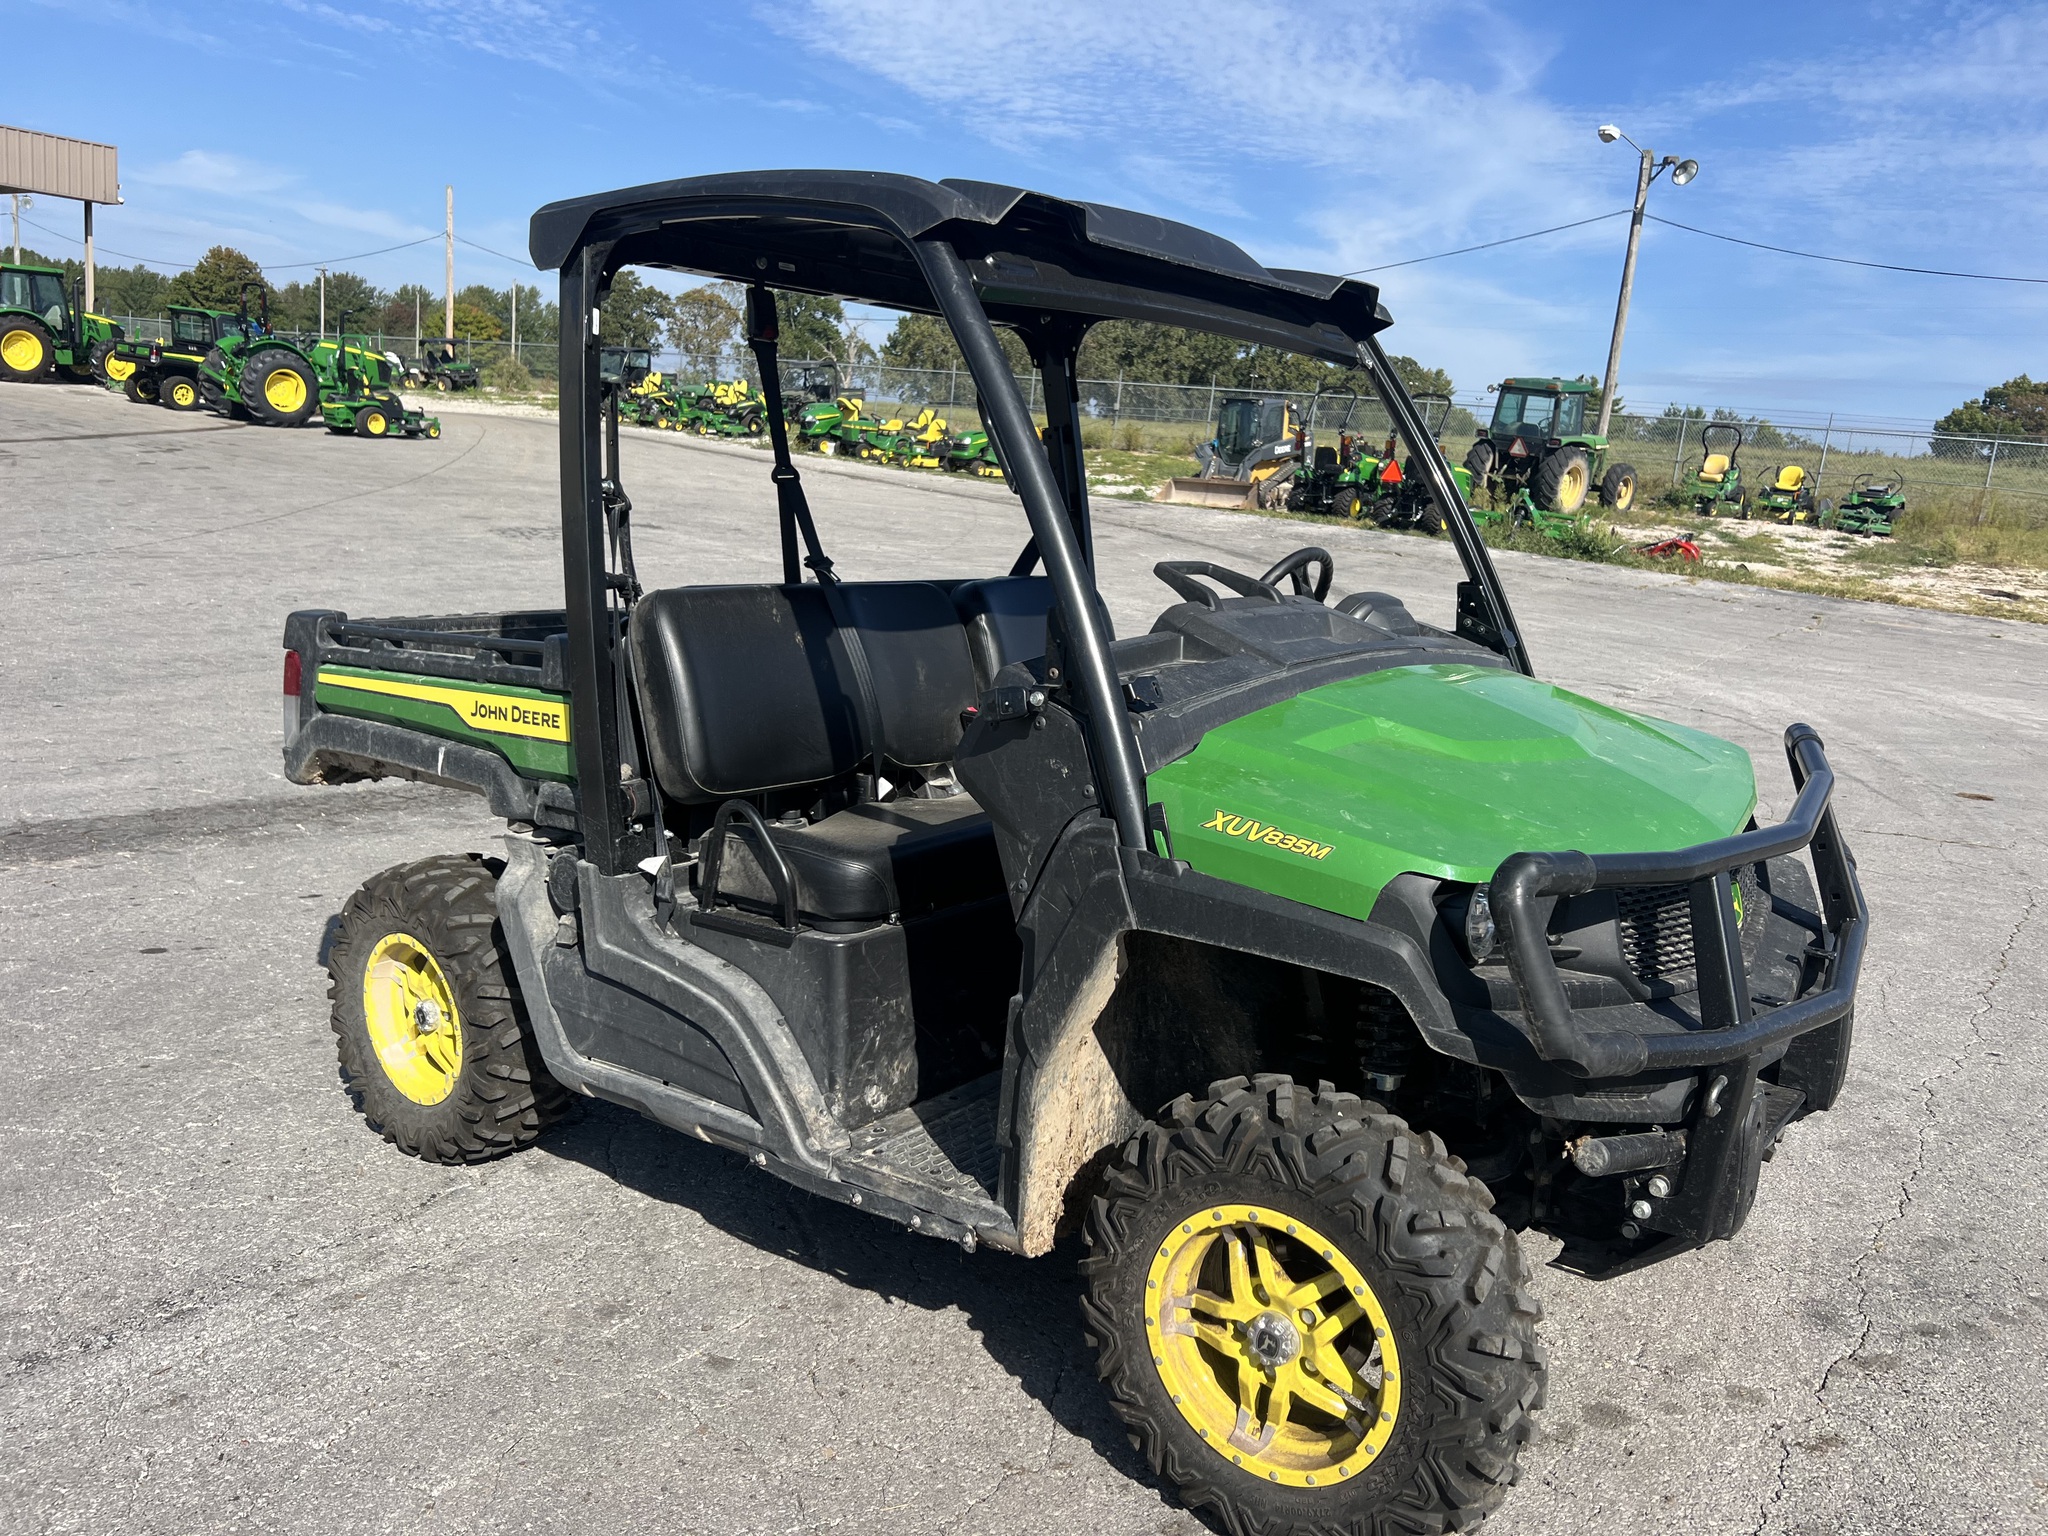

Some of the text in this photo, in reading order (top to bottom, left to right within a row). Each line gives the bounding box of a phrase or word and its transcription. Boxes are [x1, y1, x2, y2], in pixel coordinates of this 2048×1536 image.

[470, 700, 560, 729] JOHN DEERE
[1200, 809, 1334, 861] XUV835M
